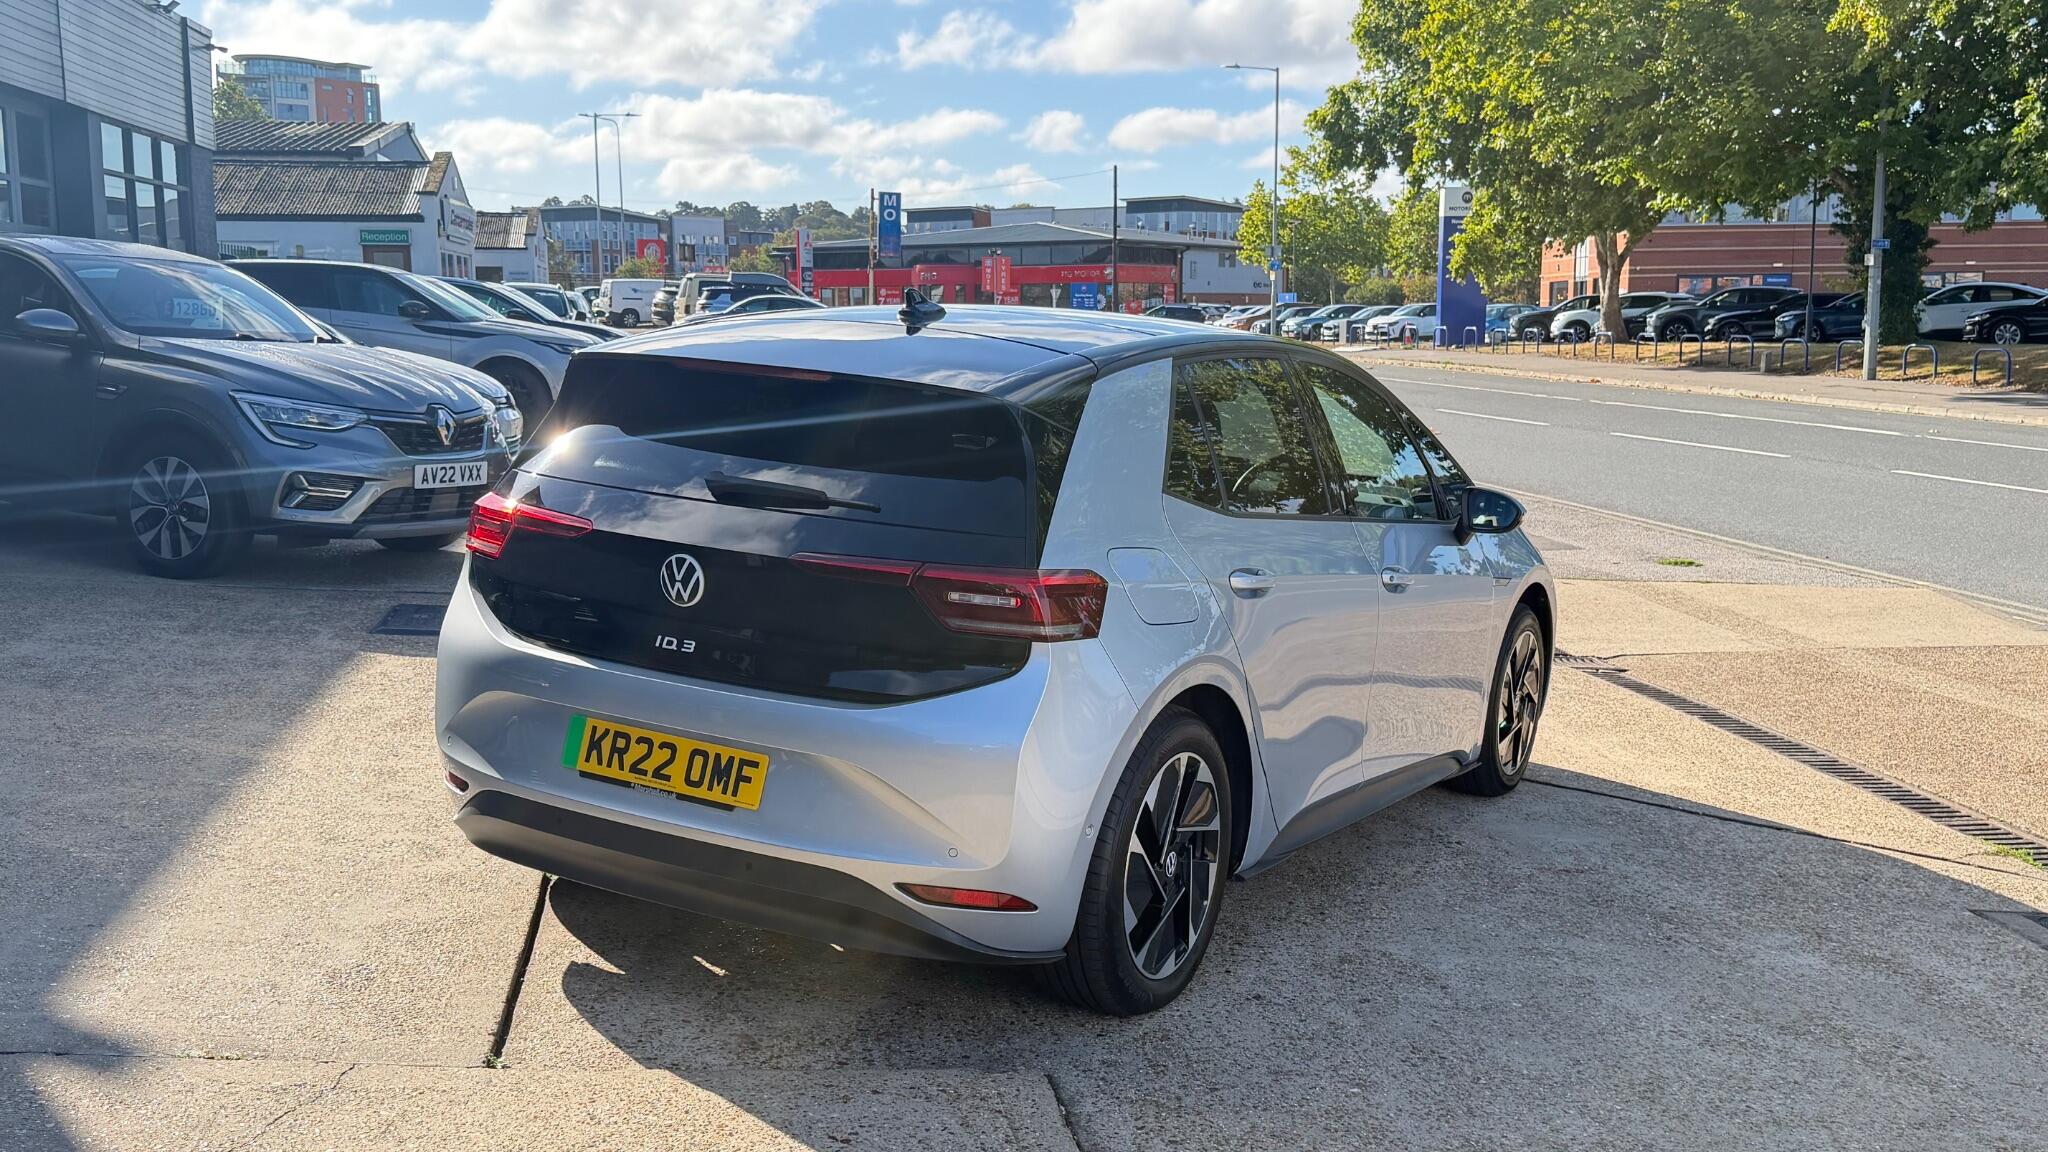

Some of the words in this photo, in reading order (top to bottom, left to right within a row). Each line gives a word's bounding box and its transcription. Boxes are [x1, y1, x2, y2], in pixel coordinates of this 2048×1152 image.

[361, 231, 408, 242] Reception
[421, 465, 456, 485] AV22
[460, 464, 482, 482] VXX
[584, 724, 678, 783] KR22
[684, 747, 760, 798] OMF
